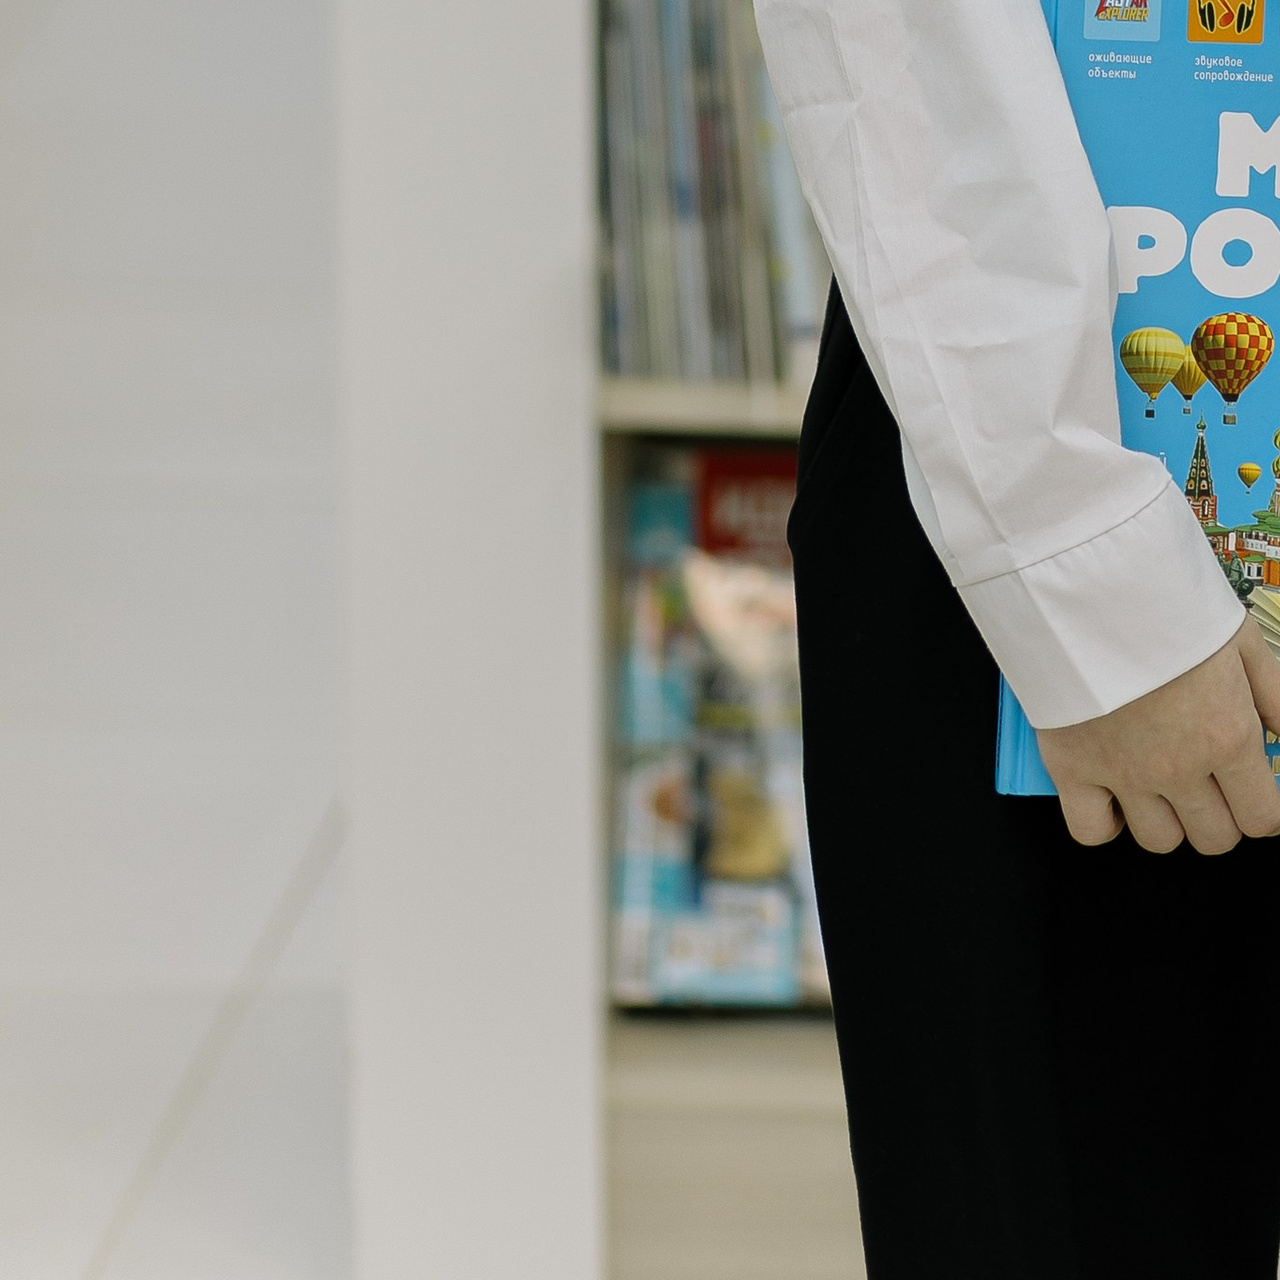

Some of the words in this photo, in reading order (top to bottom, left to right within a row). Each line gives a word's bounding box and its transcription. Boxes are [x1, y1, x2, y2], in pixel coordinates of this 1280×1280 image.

[1088, 51, 1152, 64] оживающие
[1194, 55, 1243, 69] звуковое
[1087, 67, 1137, 79] объекты
[1193, 70, 1274, 83] сопровождение
